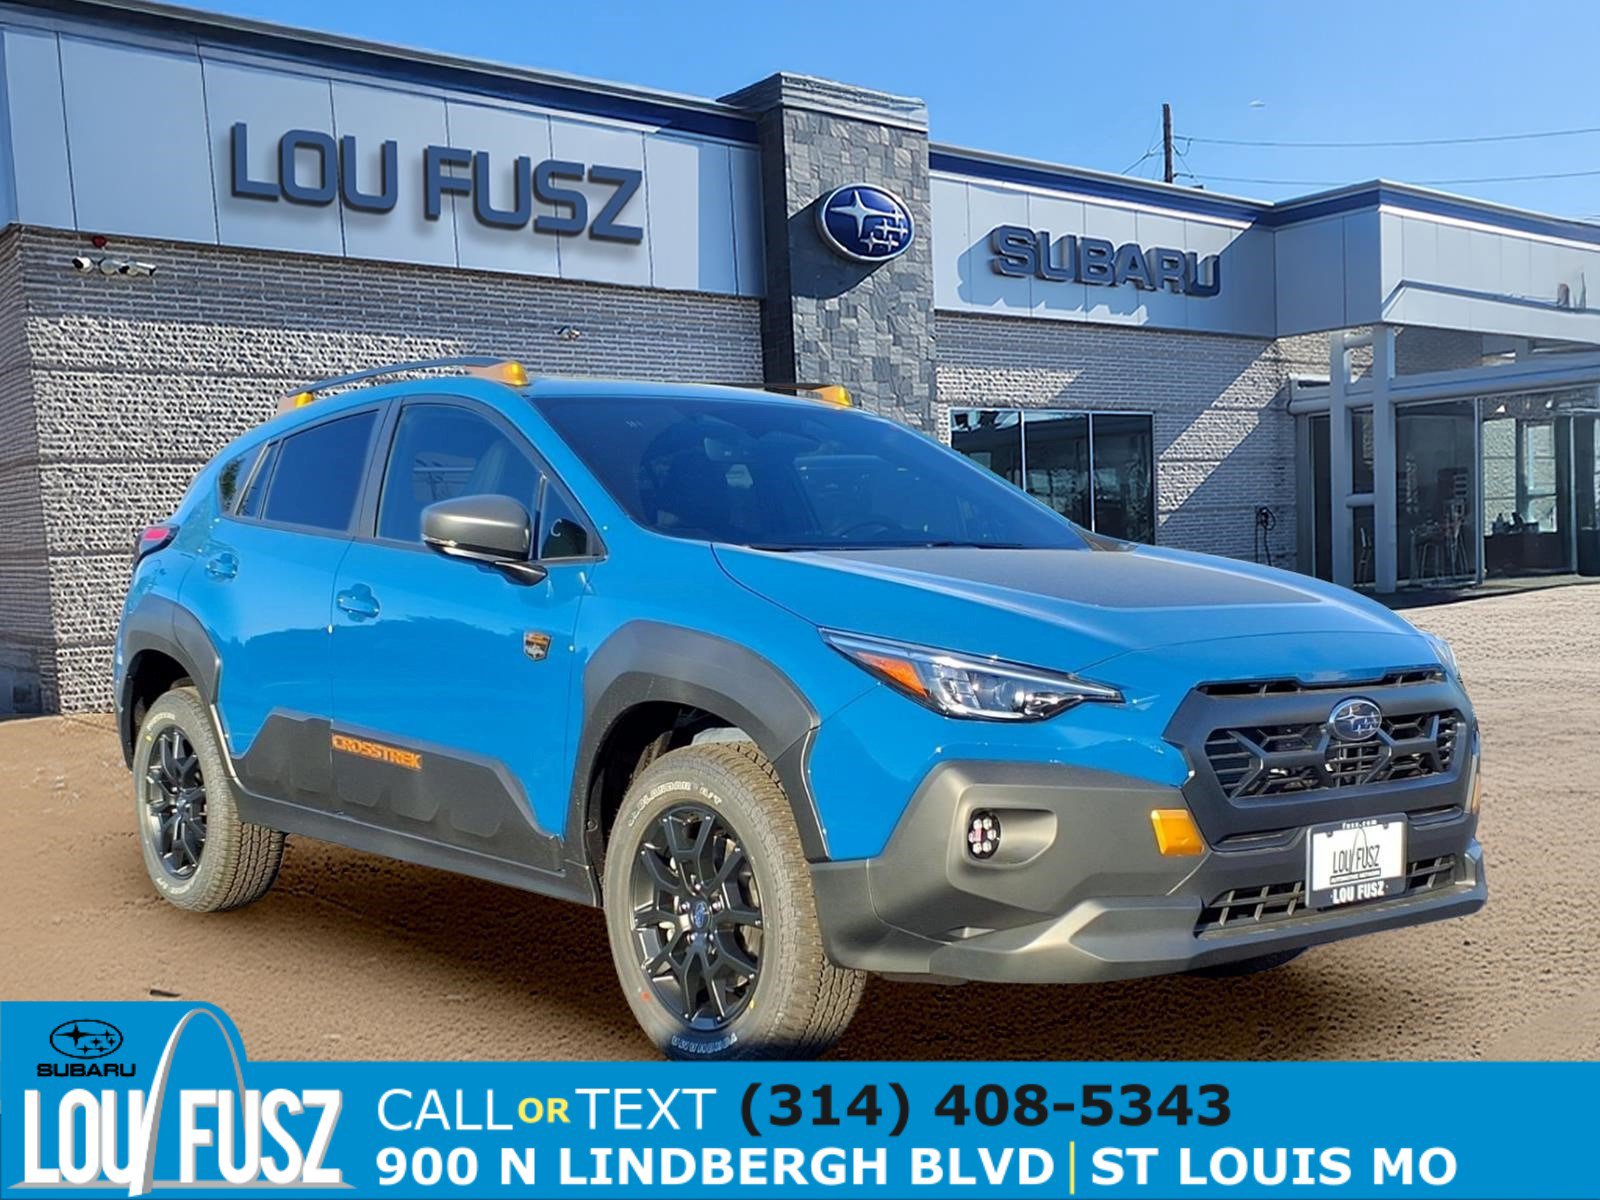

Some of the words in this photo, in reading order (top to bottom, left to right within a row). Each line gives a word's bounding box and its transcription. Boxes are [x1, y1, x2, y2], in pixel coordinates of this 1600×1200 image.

[231, 122, 398, 214] LOU
[424, 144, 644, 244] FUSZ
[991, 224, 1221, 298] SUBARU
[331, 733, 423, 770] CROSSTREK
[1332, 850, 1353, 874] LOU
[1355, 844, 1381, 870] FUSZ
[1332, 885, 1355, 905] LOU
[1357, 880, 1385, 899] FUSZ
